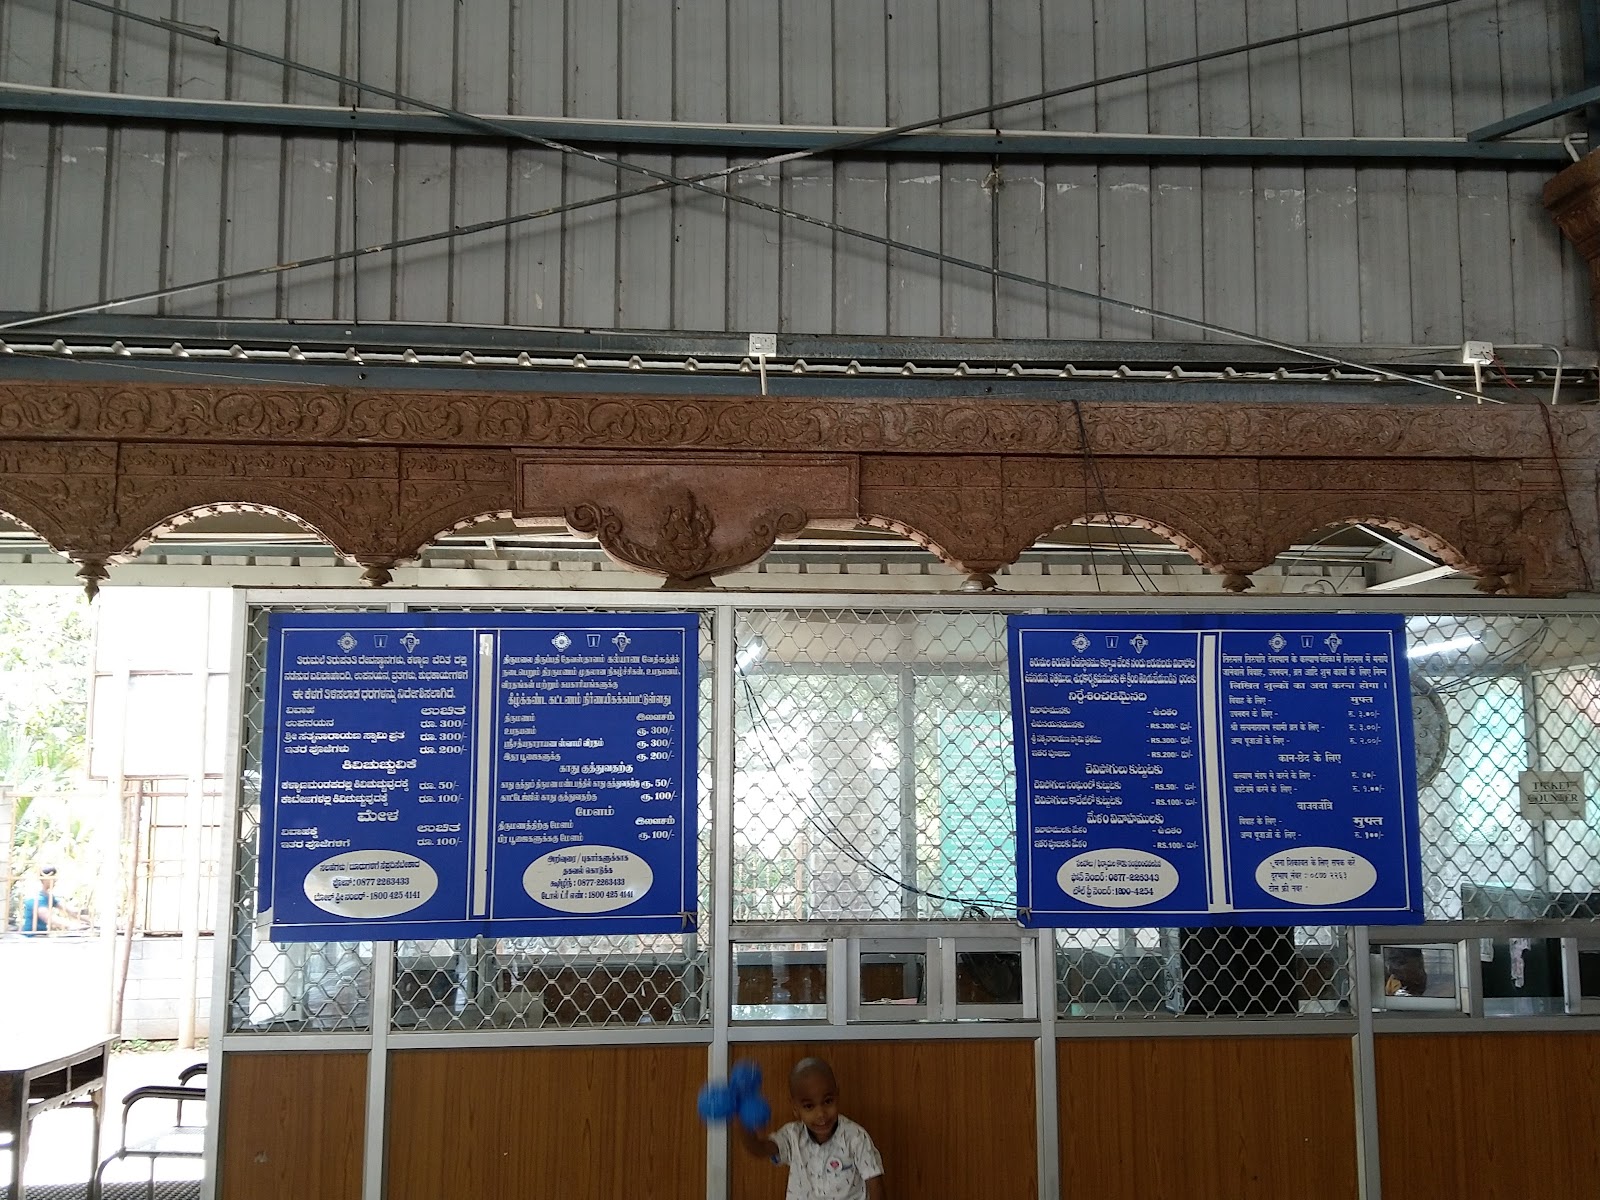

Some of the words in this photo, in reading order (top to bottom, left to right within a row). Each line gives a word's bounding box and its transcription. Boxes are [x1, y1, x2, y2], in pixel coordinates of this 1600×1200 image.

[439, 720, 468, 728] 300/-
[651, 726, 675, 735] 300/-
[439, 732, 467, 741] 300/-
[651, 739, 675, 747] 300/-
[439, 746, 467, 754] 200/-
[650, 752, 675, 761] 200/-
[1313, 752, 1321, 762] के
[1325, 751, 1341, 763] लिए
[438, 782, 459, 790] 50/-
[655, 778, 673, 788] 50/-
[438, 795, 464, 803] 100/-
[655, 791, 678, 801] 100/-
[652, 831, 675, 840] 100/-
[436, 838, 462, 846] 100/-
[356, 878, 376, 886] 0877
[405, 891, 420, 899] 4141
